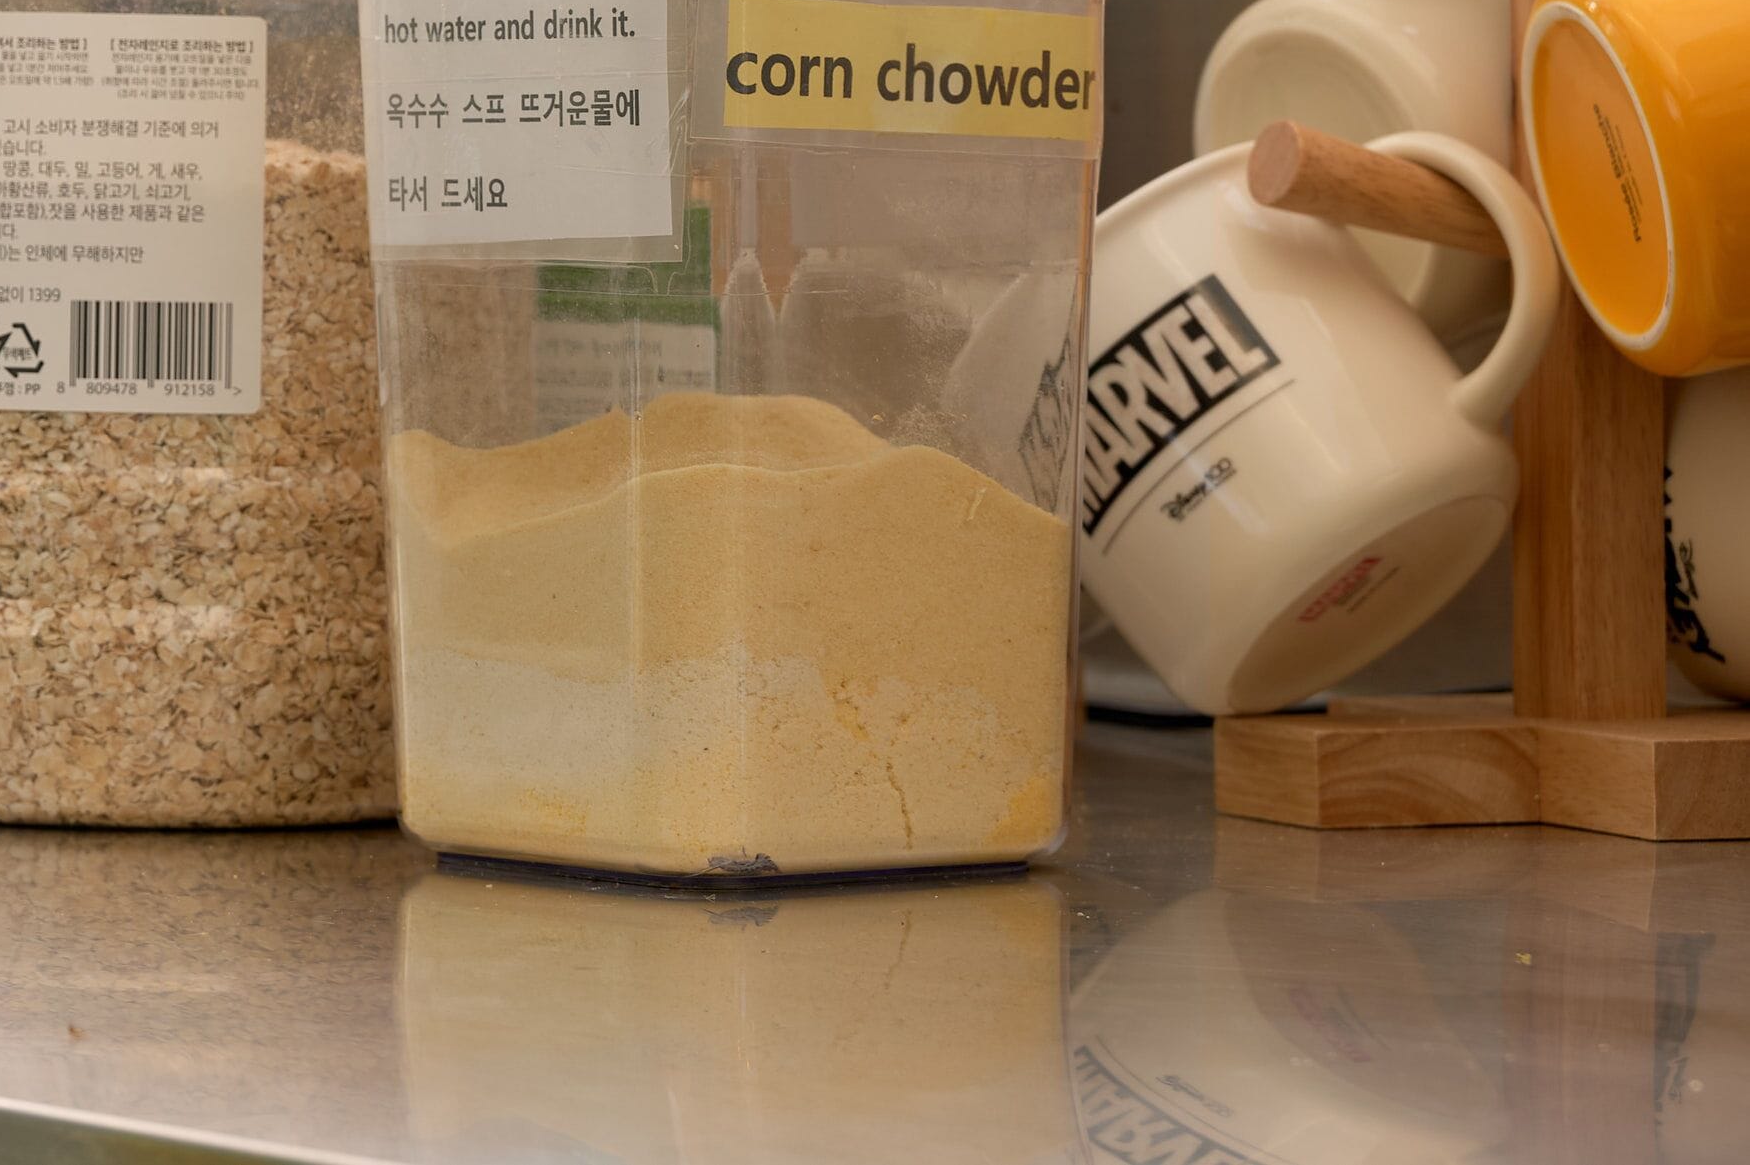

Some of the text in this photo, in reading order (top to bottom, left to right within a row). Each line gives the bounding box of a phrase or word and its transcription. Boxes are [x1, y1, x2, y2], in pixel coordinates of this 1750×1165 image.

[384, 7, 636, 44] hot water and drink it.
[726, 43, 1095, 111] corn chowder
[387, 89, 640, 129] 옥수수 스프 뜨거운물에
[4, 117, 31, 136] 고시
[35, 118, 77, 136] 소비자
[82, 119, 139, 137] 분쟁해결
[144, 120, 187, 138] 기준에
[191, 121, 220, 139] 의거
[389, 176, 508, 212] 타서 드세요
[82, 203, 125, 222] 사용한
[129, 203, 173, 223] 제품과
[177, 204, 206, 223] 같은
[25, 244, 68, 263] 인체에
[72, 244, 145, 264] 무해하지만
[29, 286, 62, 302] 1399
[24, 383, 41, 395] PP
[56, 382, 216, 397] 8 809478 912158
